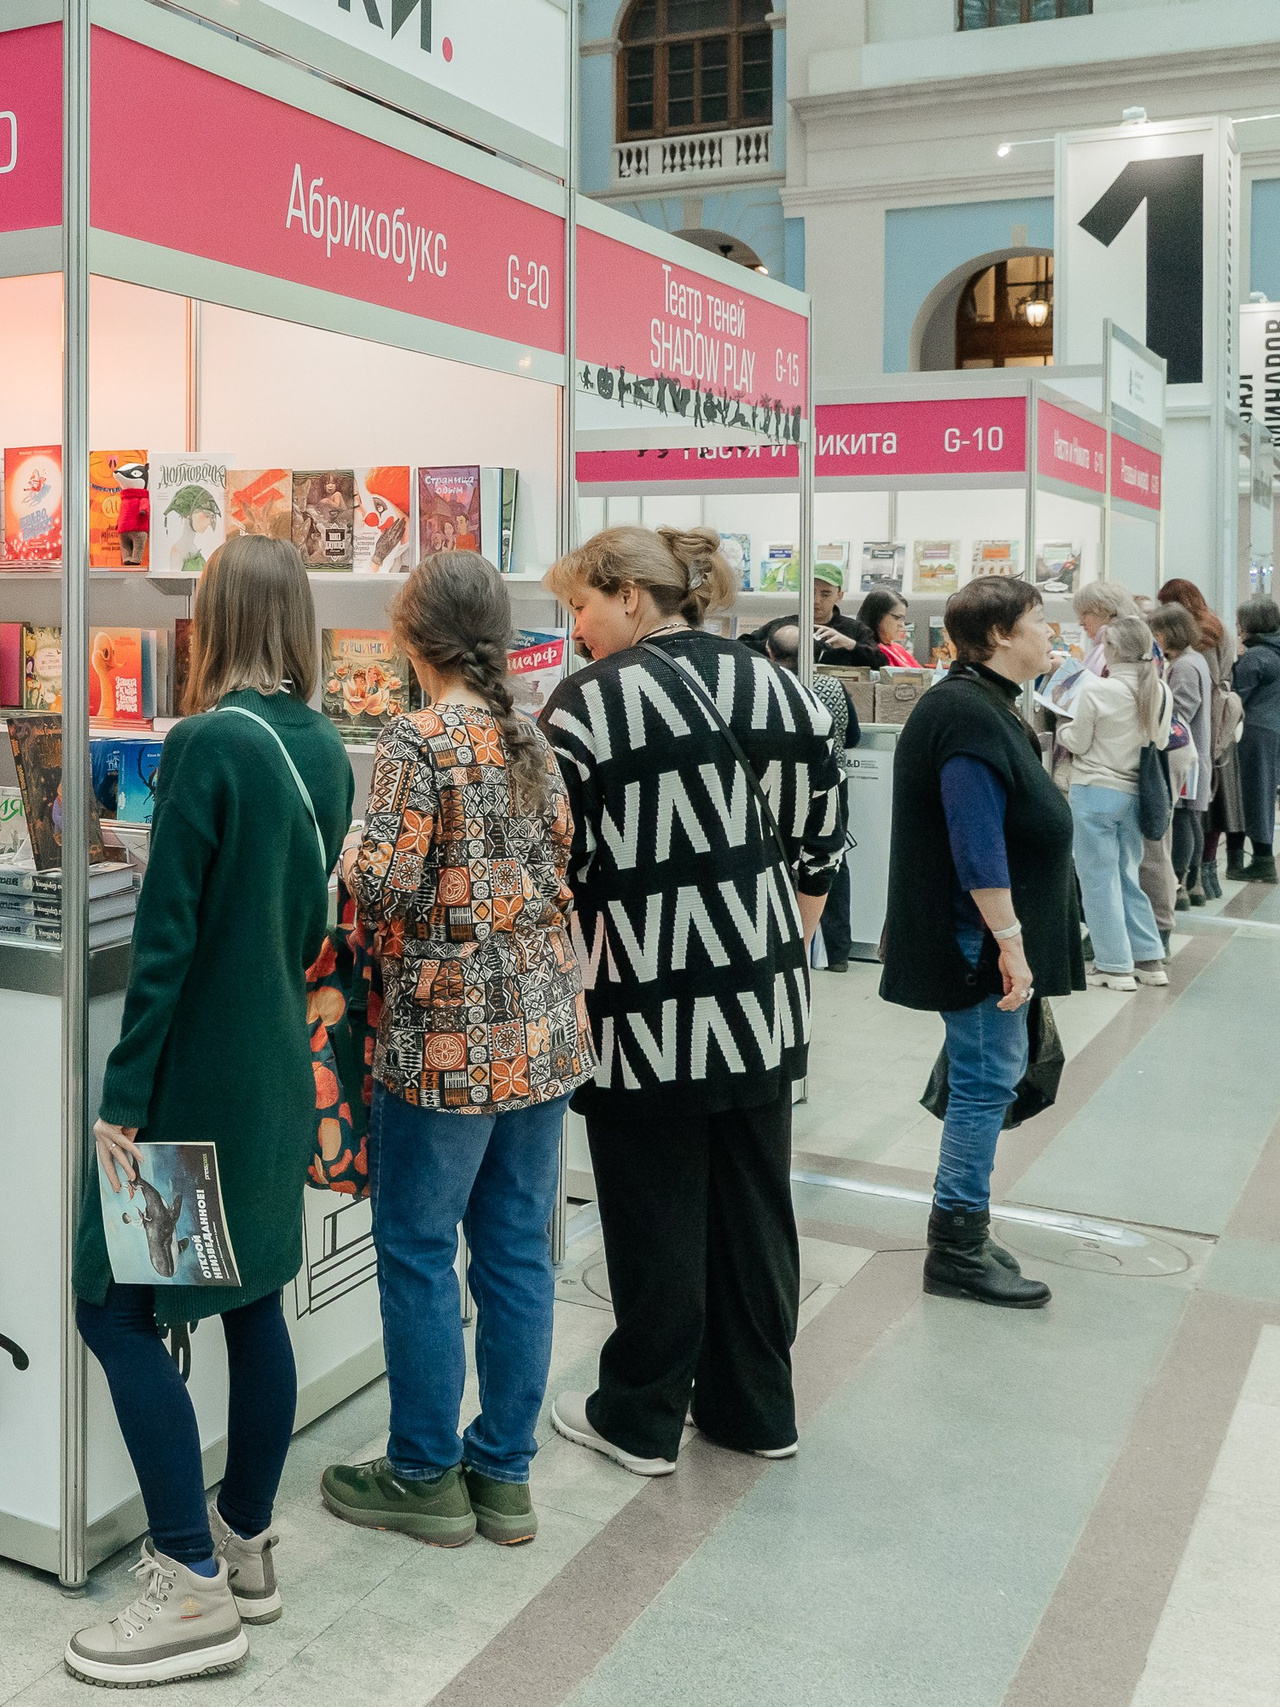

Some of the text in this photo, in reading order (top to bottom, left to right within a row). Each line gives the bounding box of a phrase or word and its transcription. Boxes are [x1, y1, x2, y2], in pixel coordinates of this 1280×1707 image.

[284, 162, 449, 283] Абрикобукс
[506, 253, 550, 311] G-20
[1078, 154, 1203, 384] 1
[662, 263, 746, 339] Театр теней
[650, 318, 755, 394] SHADOW PLAY
[775, 348, 799, 387] G-15
[943, 426, 1004, 452] G-10
[424, 475, 475, 487] Страница
[340, 638, 393, 655] КУВШИНКИ
[203, 1153, 212, 1181] presspass
[190, 1234, 212, 1279] ОТКРОЙ
[196, 1188, 224, 1280] НЕИЗВЕДАННОЕ!
